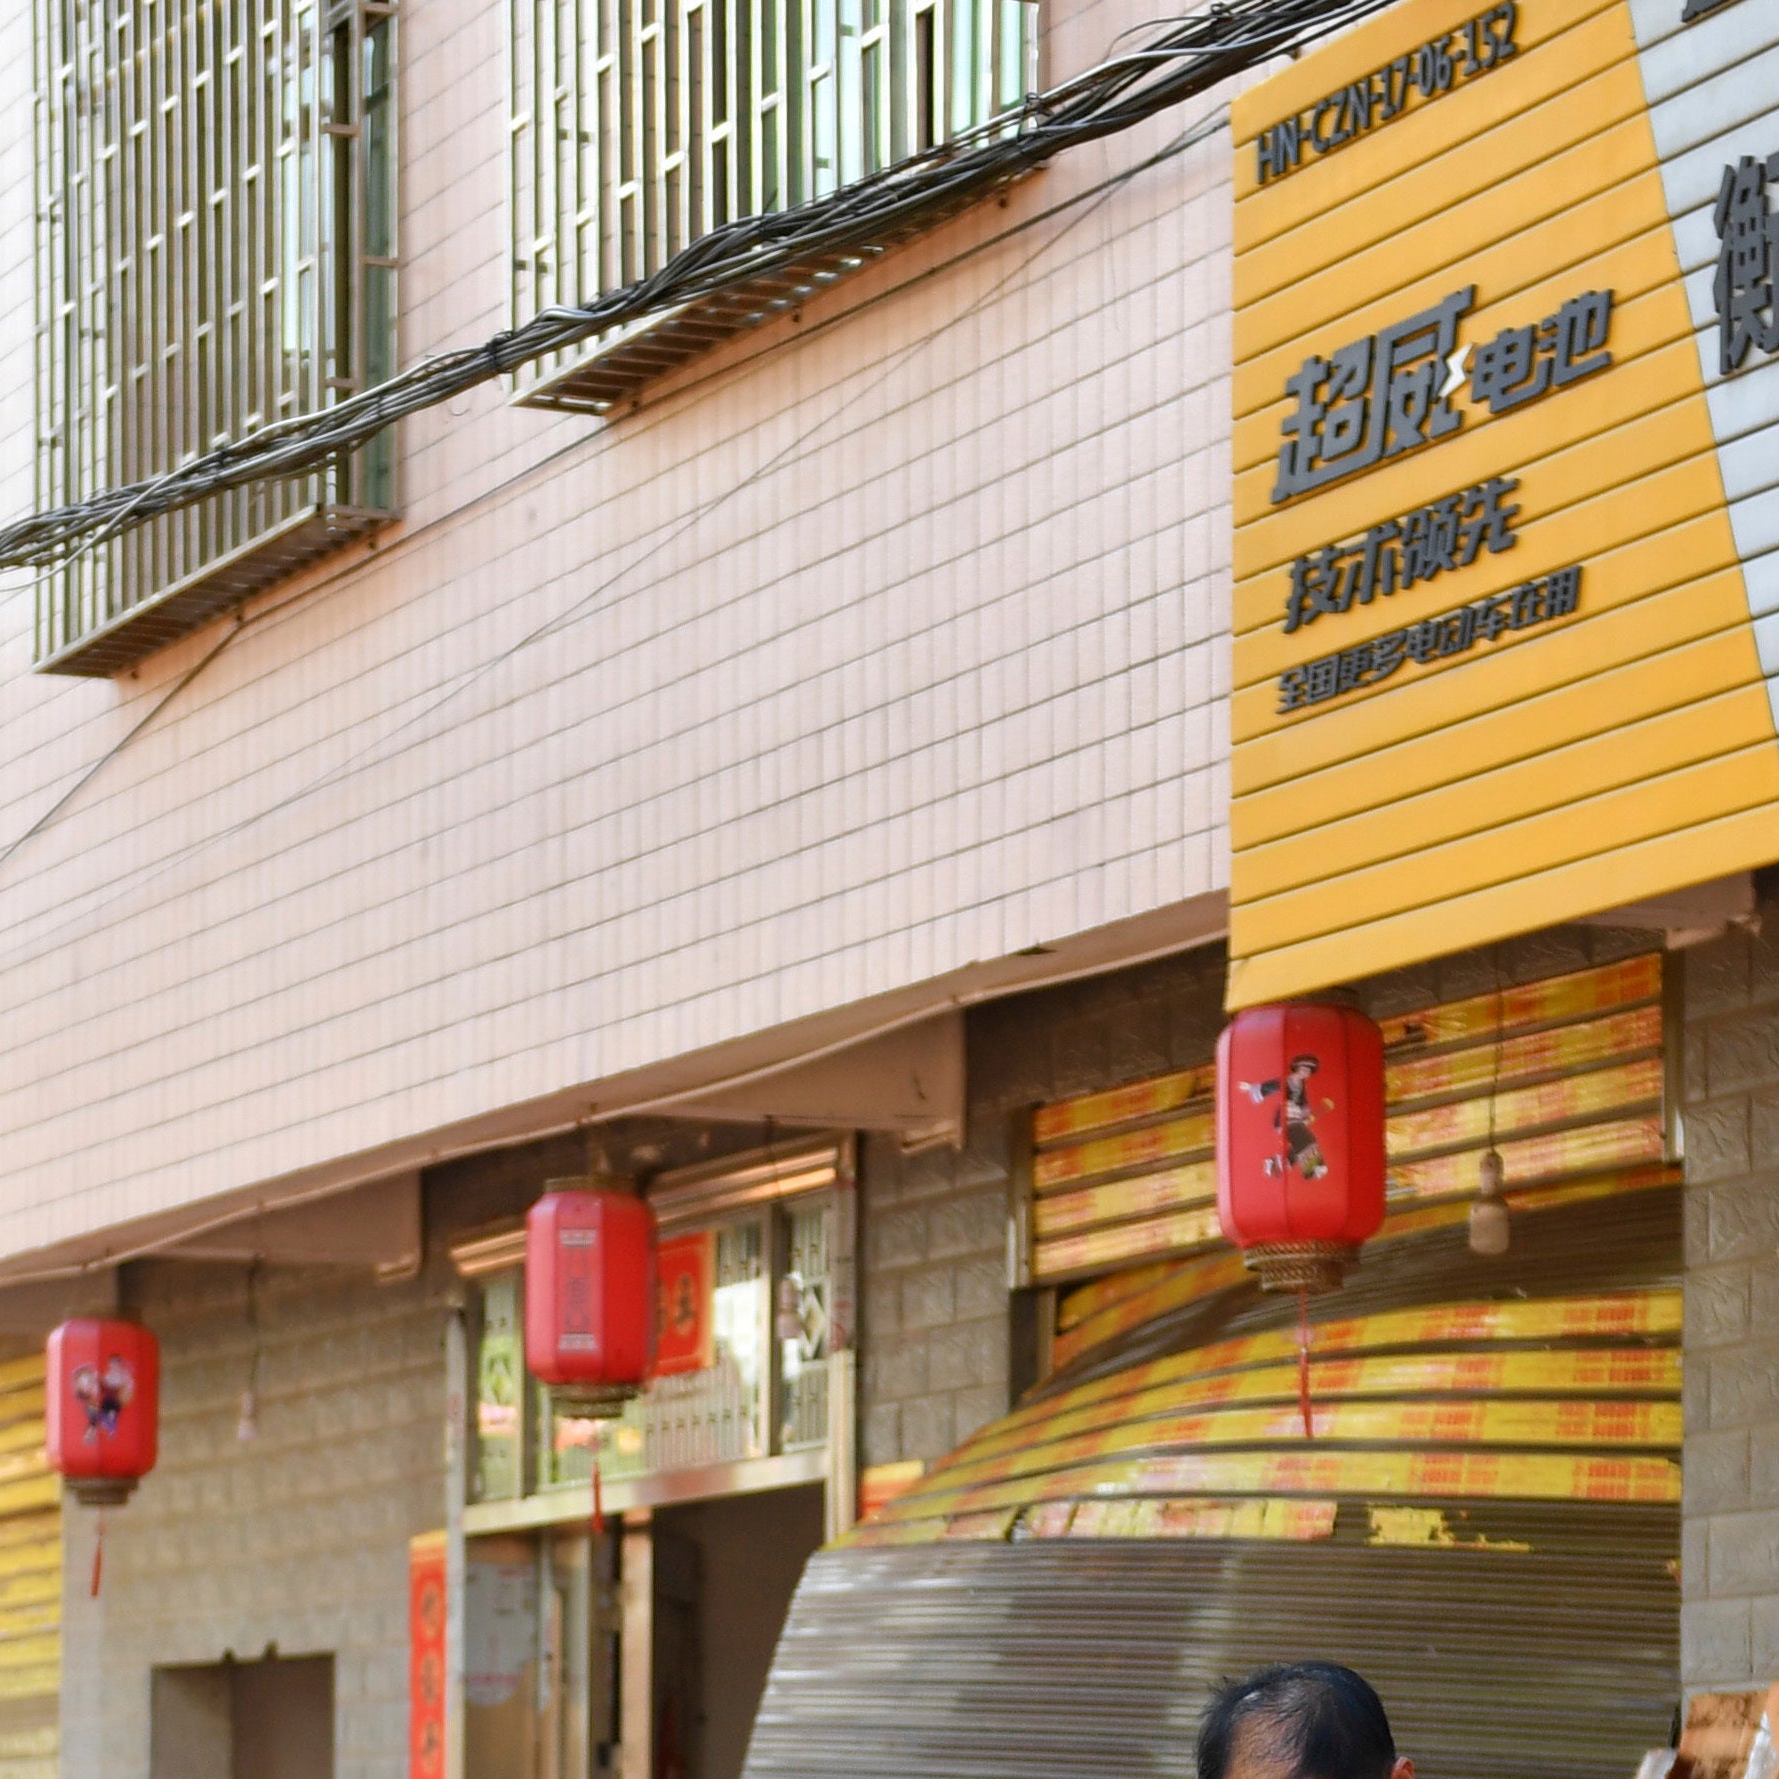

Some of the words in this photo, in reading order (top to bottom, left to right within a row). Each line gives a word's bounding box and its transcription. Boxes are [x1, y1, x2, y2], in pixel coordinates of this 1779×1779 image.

[1256, 0, 1517, 185] HN-CZN-17-06-152
[1284, 477, 1521, 634] 技术领先
[1275, 563, 1583, 715] 全国更多电动车在用
